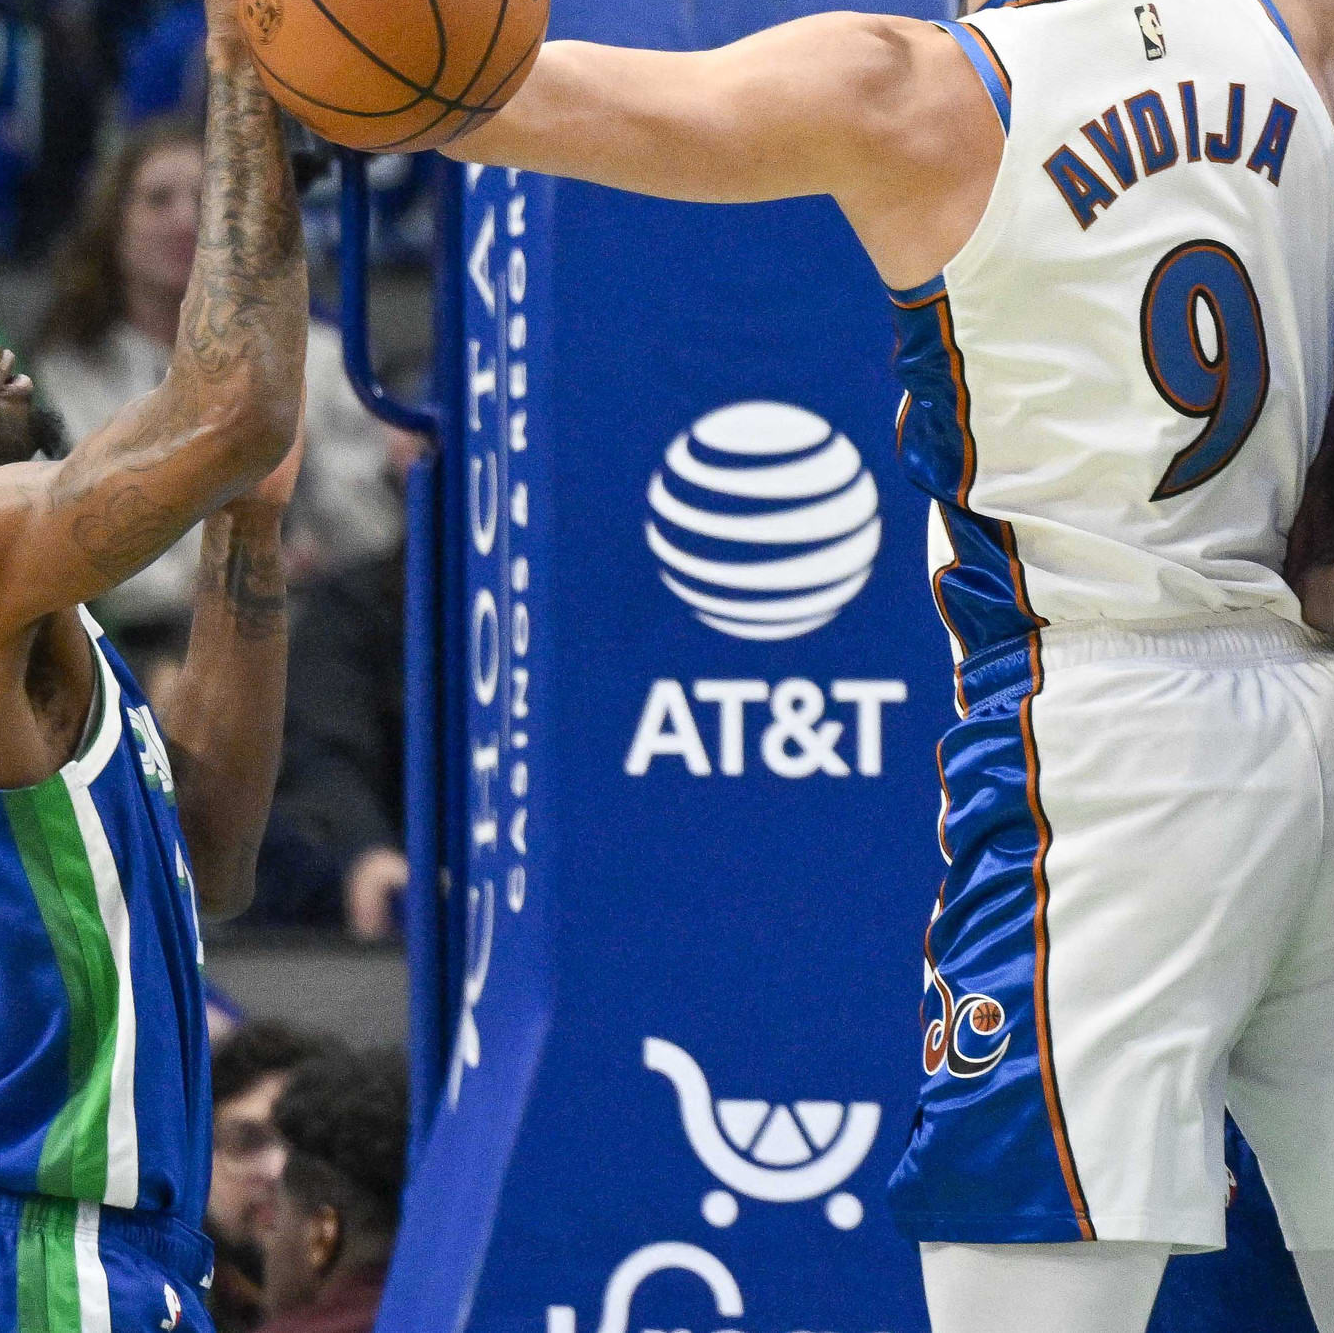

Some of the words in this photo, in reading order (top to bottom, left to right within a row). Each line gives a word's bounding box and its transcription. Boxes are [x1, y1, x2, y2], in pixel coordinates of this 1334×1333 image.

[1042, 80, 1298, 230] AVDIJA
[1140, 239, 1270, 502] 9
[464, 161, 500, 1009] CHOCTA
[624, 677, 908, 778] AT&T
